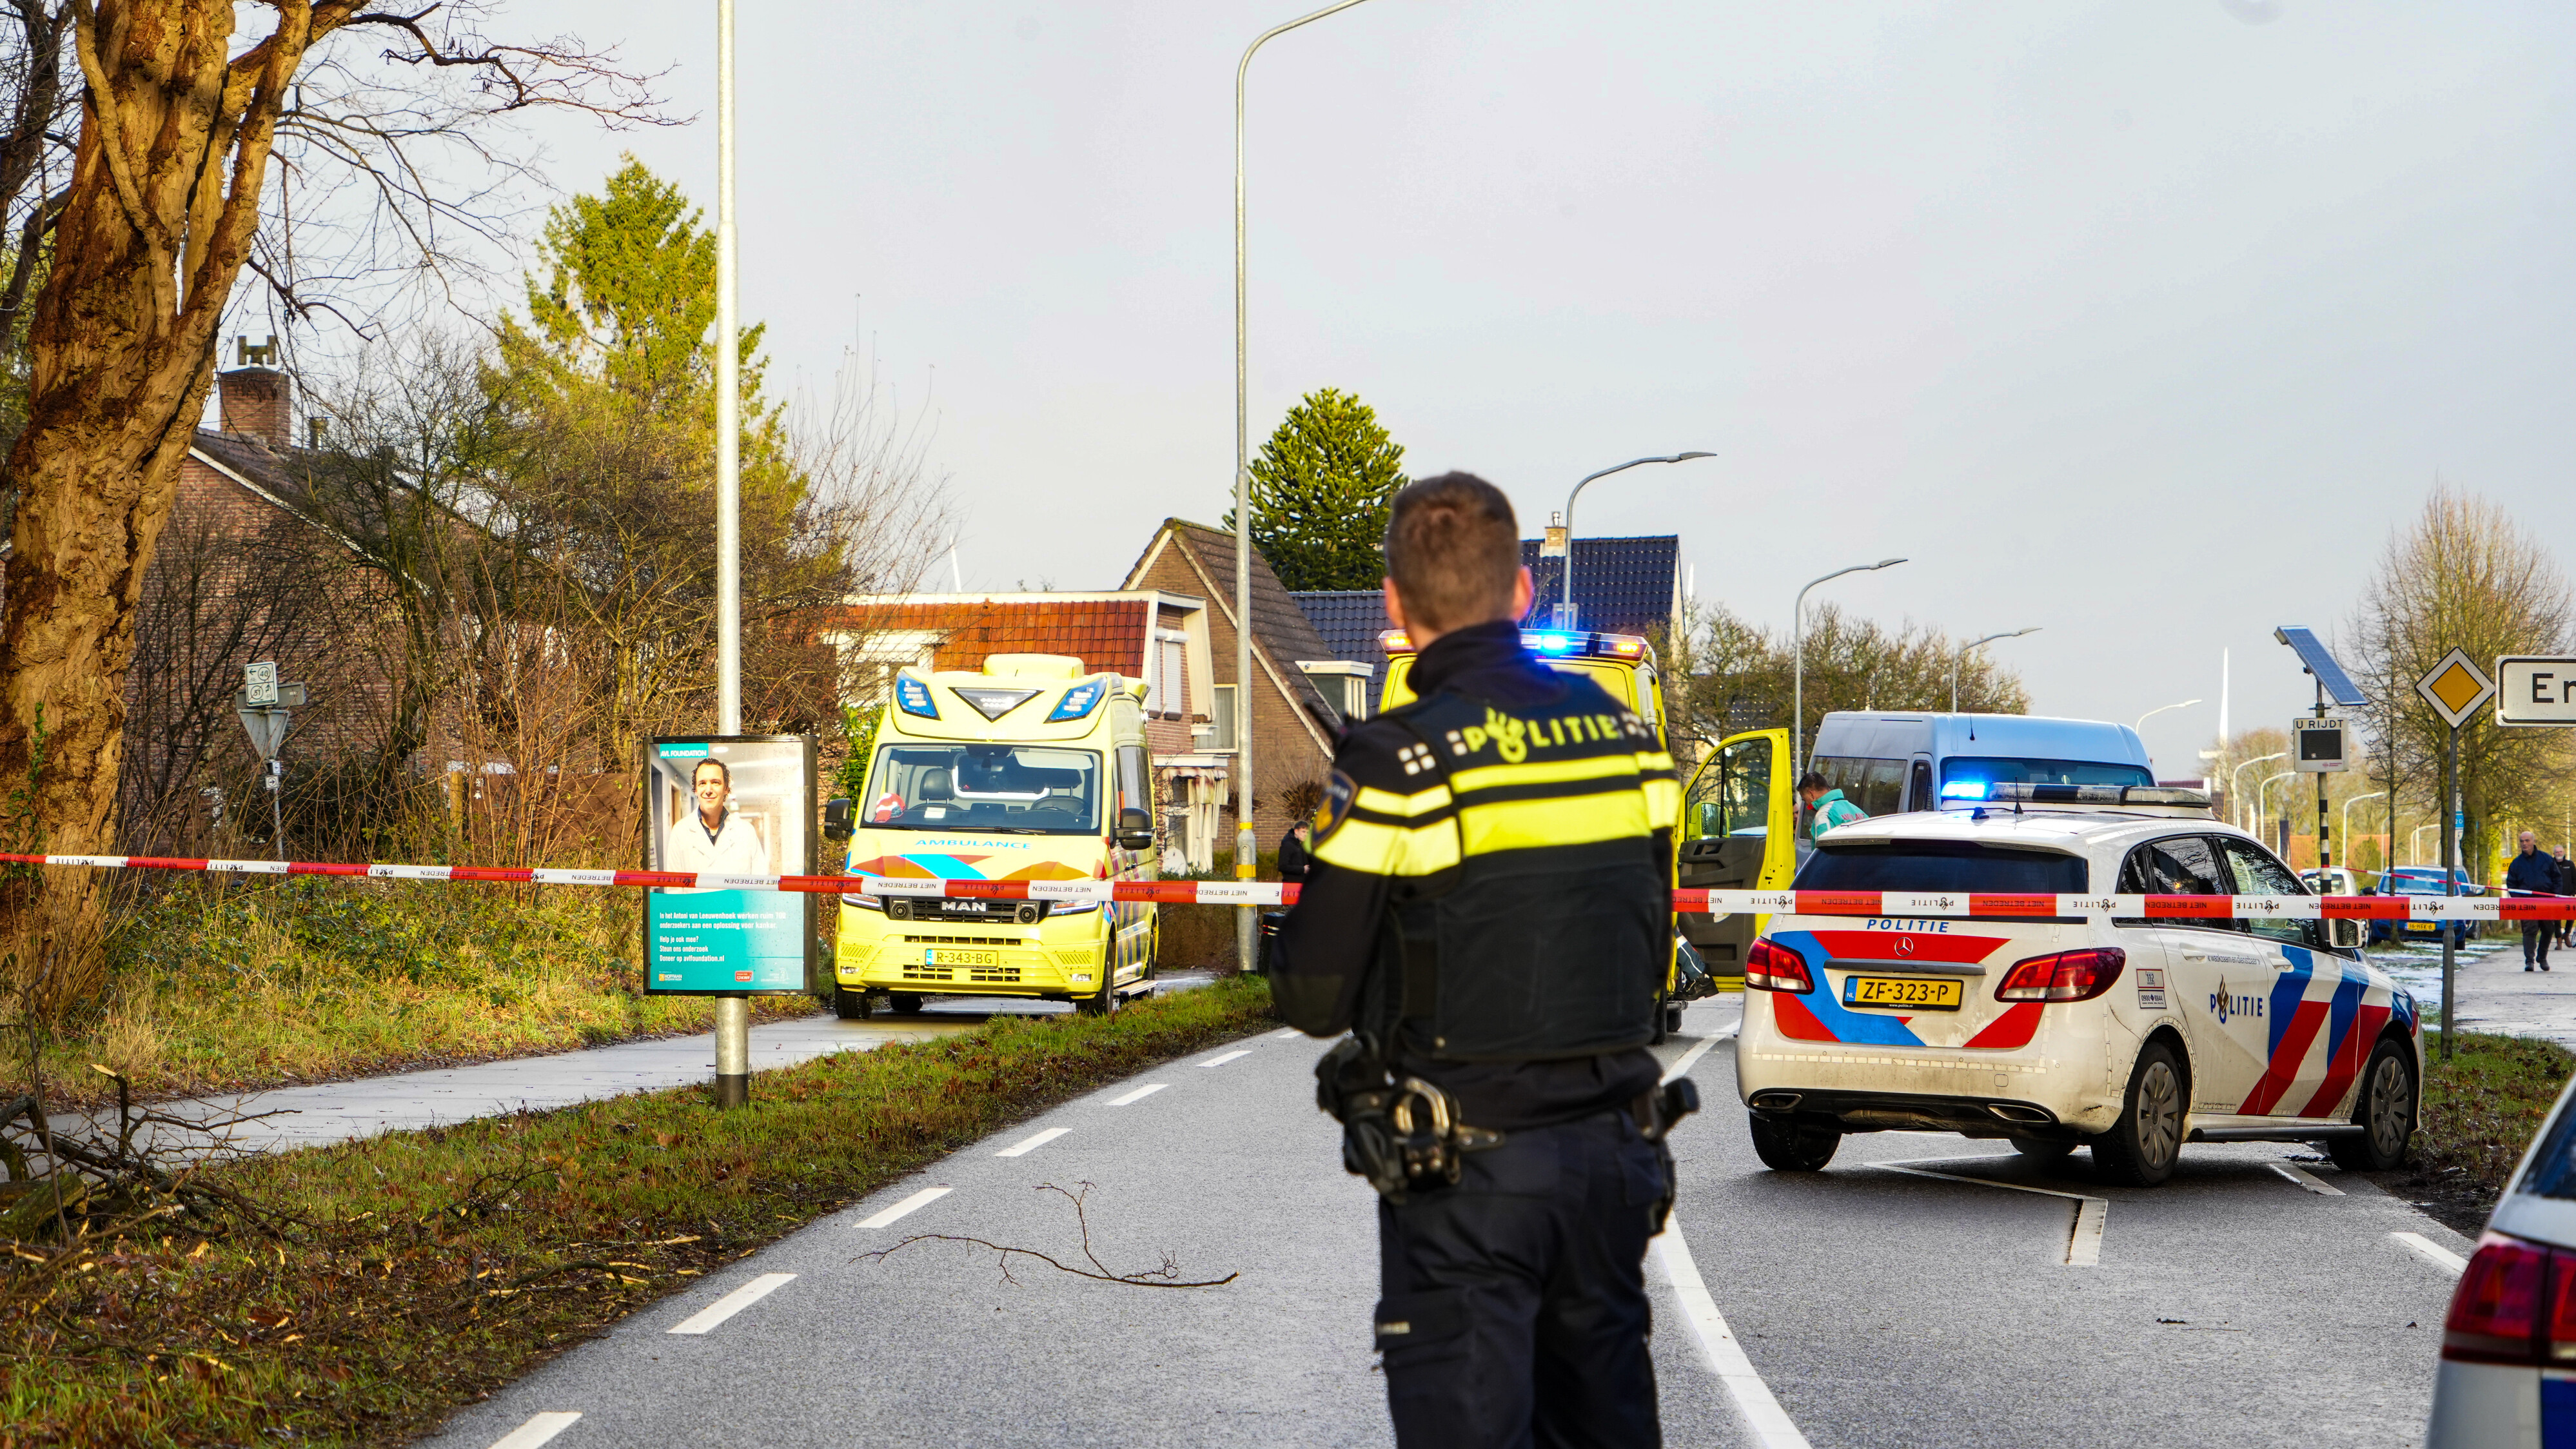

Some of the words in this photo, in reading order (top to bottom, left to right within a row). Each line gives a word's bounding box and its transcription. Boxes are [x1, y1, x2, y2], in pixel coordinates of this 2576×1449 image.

[2296, 720, 2303, 729] U
[2308, 720, 2343, 729] RIJDT
[916, 840, 1031, 849] AMBULANCE
[941, 901, 987, 912] MAN
[1867, 920, 1949, 932] POLITIE
[937, 952, 992, 964] R-343-BG
[1863, 981, 1949, 1001] ZF-323-P
